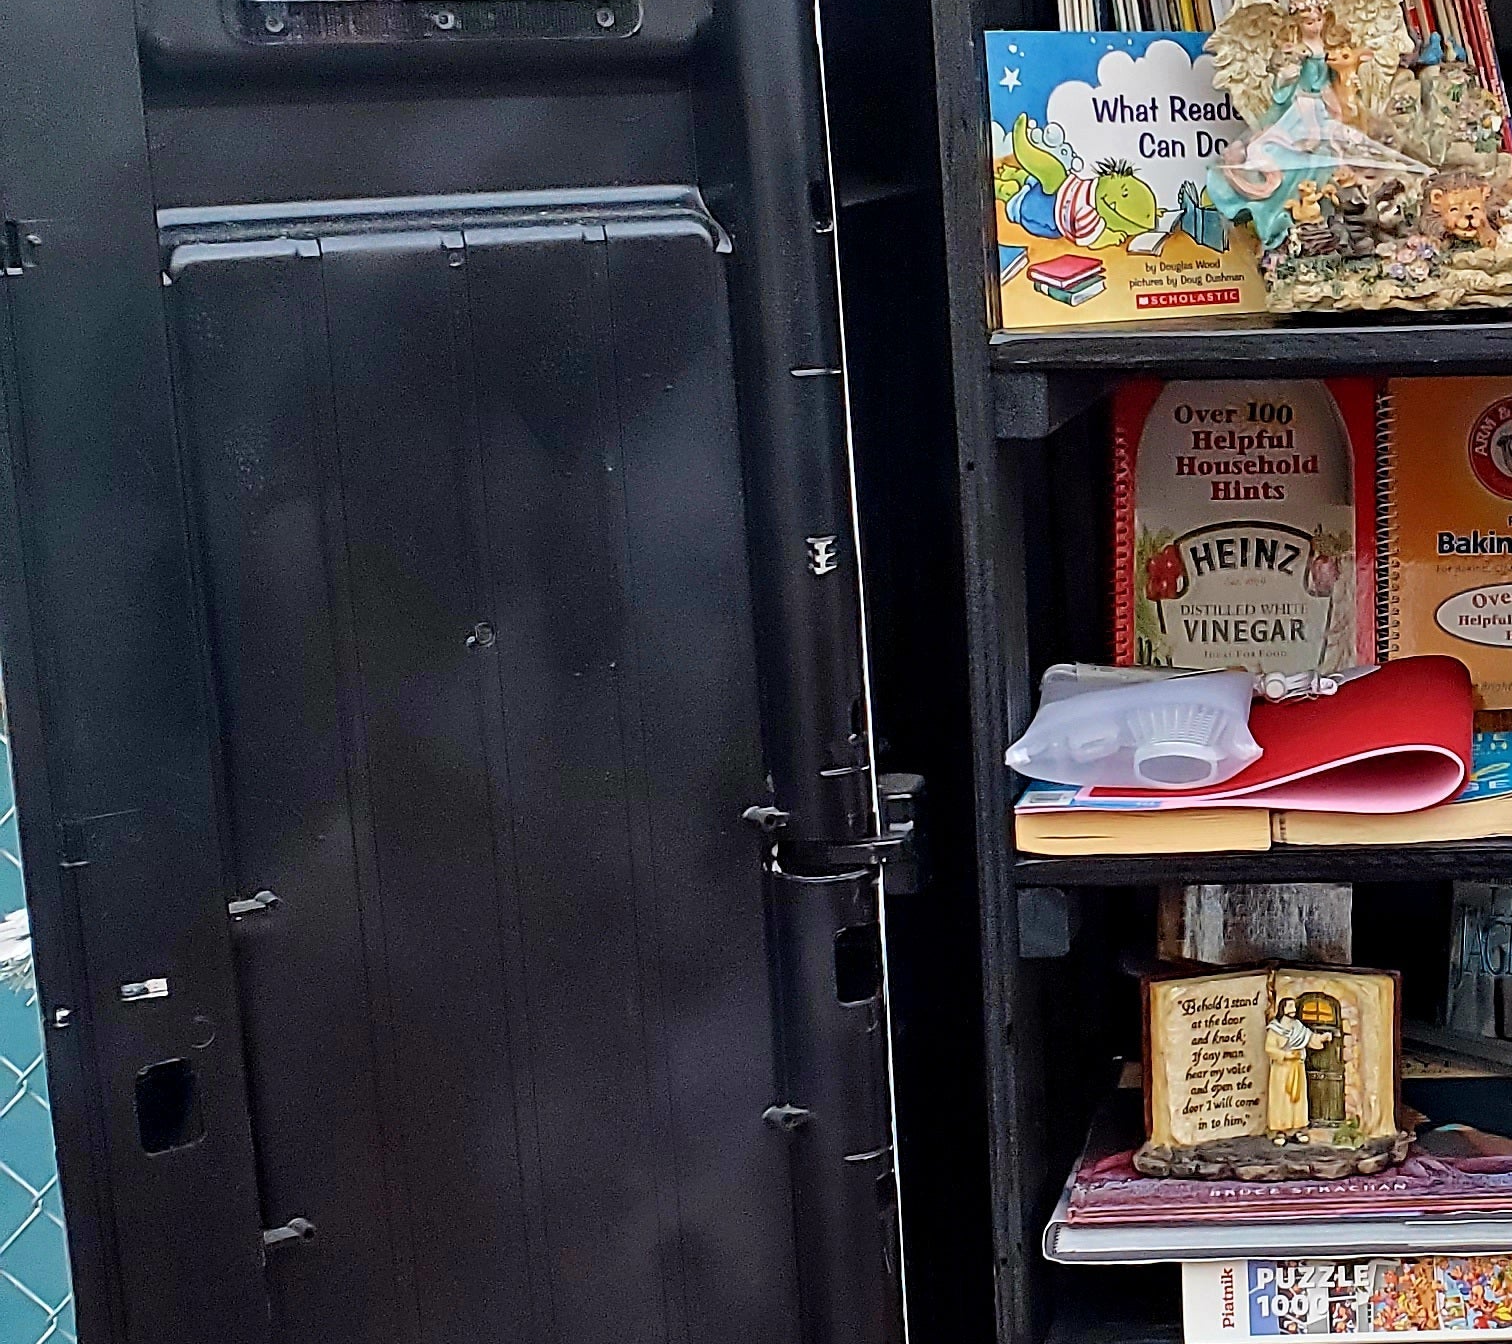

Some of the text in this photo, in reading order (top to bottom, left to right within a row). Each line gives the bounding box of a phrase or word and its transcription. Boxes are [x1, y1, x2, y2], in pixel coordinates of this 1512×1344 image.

[1092, 93, 1245, 123] What Reade
[1139, 131, 1229, 159] Can Do
[1145, 258, 1220, 274] by Douglas Wood
[1151, 290, 1238, 305] SCHOLASTIC
[1174, 402, 1293, 424] Over 100
[1475, 416, 1497, 456] ARM
[1498, 407, 1511, 420] &
[1192, 430, 1294, 455] Helpful
[1176, 455, 1319, 476] Household
[1211, 480, 1285, 501] Hints
[1190, 538, 1300, 576] HEINZ
[1180, 603, 1308, 616] DISTILLED WHITE
[1183, 619, 1306, 643] VINEGAR
[1224, 997, 1230, 1009] I
[1231, 991, 1260, 1008] stand
[1192, 1010, 1245, 1029] at the door
[1192, 1031, 1211, 1045] and
[1192, 1048, 1244, 1067] If any man
[1185, 1063, 1251, 1083] hear my voice
[1191, 1077, 1253, 1098] and open the
[1182, 1096, 1260, 1115] door I will come
[1198, 1118, 1207, 1130] in
[1211, 1118, 1220, 1129] to
[1291, 1183, 1407, 1194] STRACHAN
[1257, 1264, 1370, 1290] PUZZLE
[1221, 1268, 1235, 1328] Piatnik
[1257, 1295, 1328, 1317] 1000
